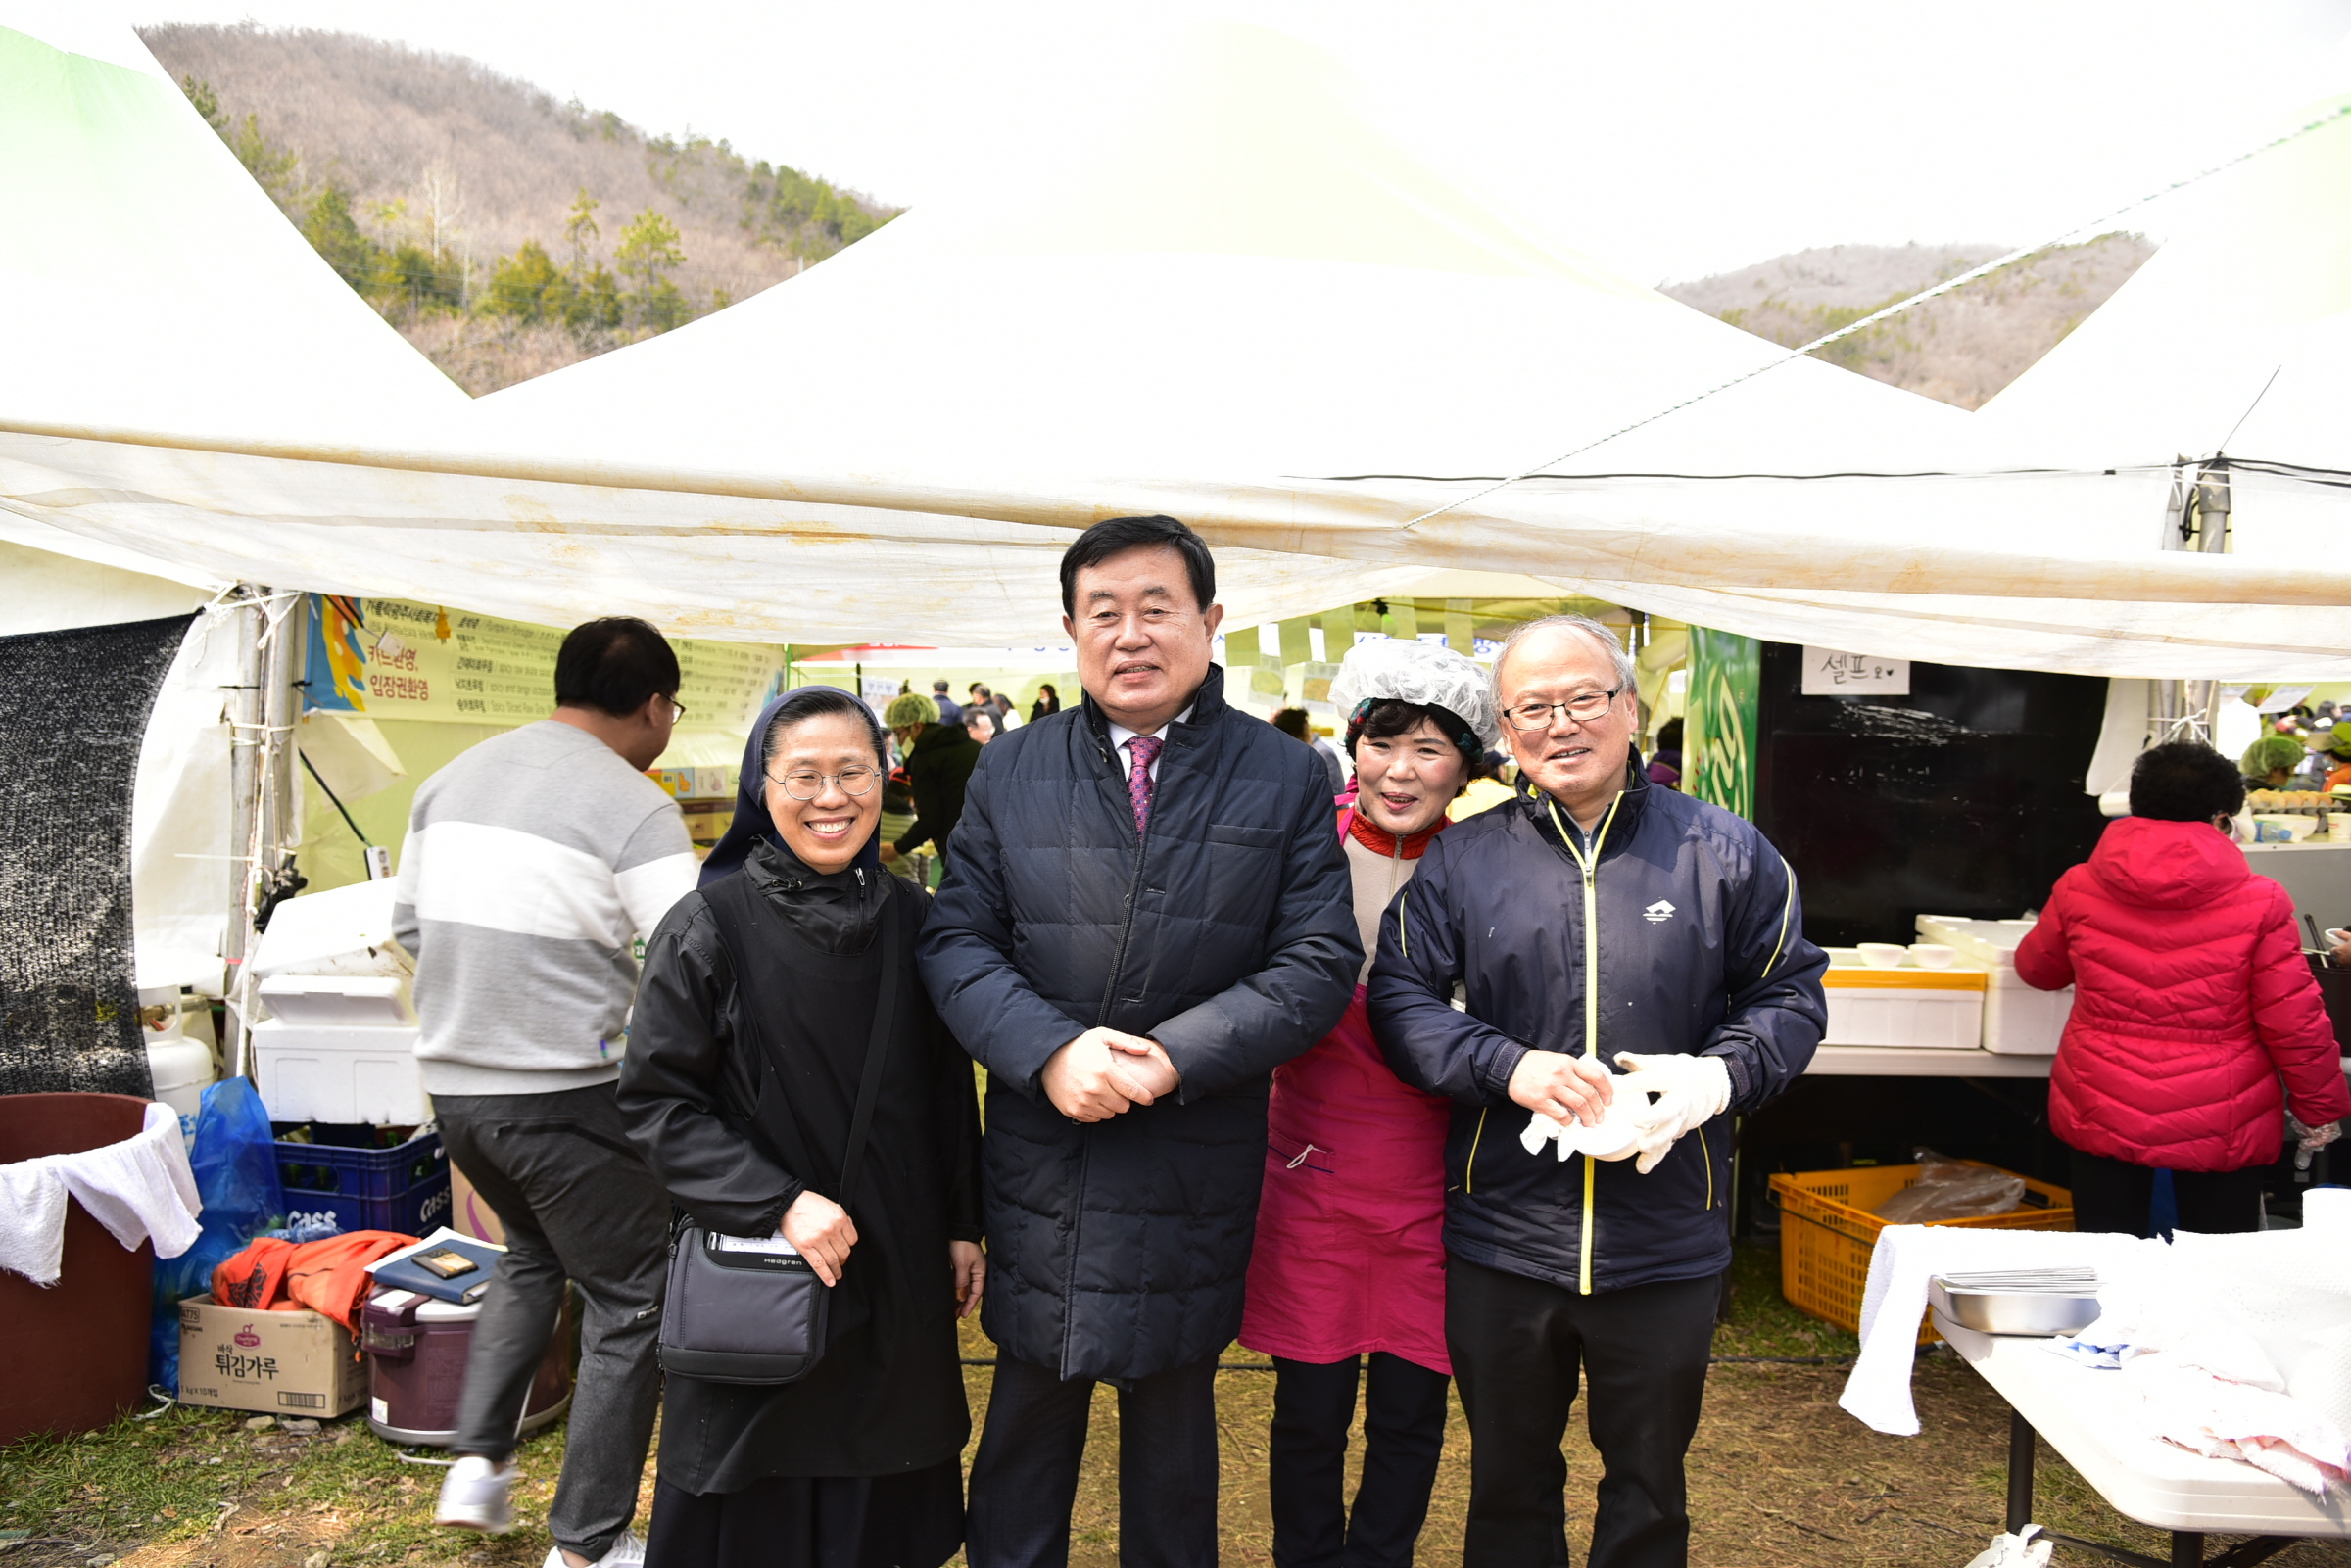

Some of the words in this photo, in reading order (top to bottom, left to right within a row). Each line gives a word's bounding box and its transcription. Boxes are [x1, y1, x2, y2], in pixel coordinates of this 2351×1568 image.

[1820, 654, 1869, 685] 셀프
[369, 674, 429, 701] 입장권환영
[420, 1185, 451, 1223] Cass
[763, 1258, 802, 1266] Hedgren
[217, 1343, 233, 1354] 바삭
[215, 1354, 279, 1380] 튀김가루
